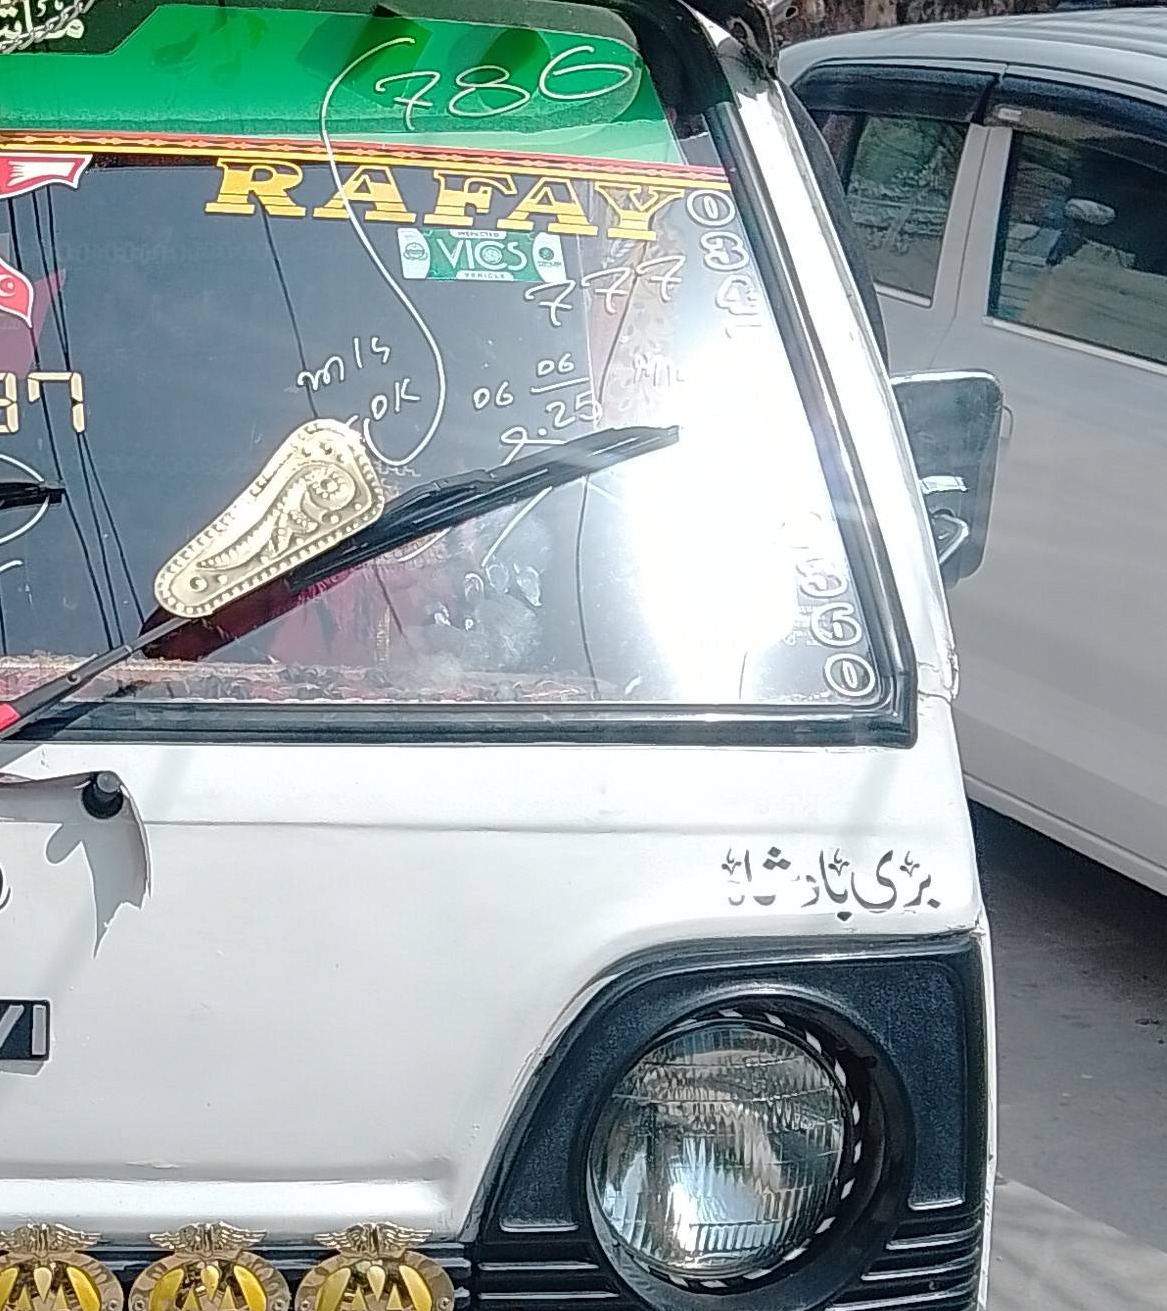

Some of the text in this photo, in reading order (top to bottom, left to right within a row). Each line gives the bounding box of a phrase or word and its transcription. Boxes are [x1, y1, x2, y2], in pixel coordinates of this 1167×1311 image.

[375, 44, 633, 131] 786
[205, 158, 685, 240] RAFAY
[437, 238, 528, 271] VICS
